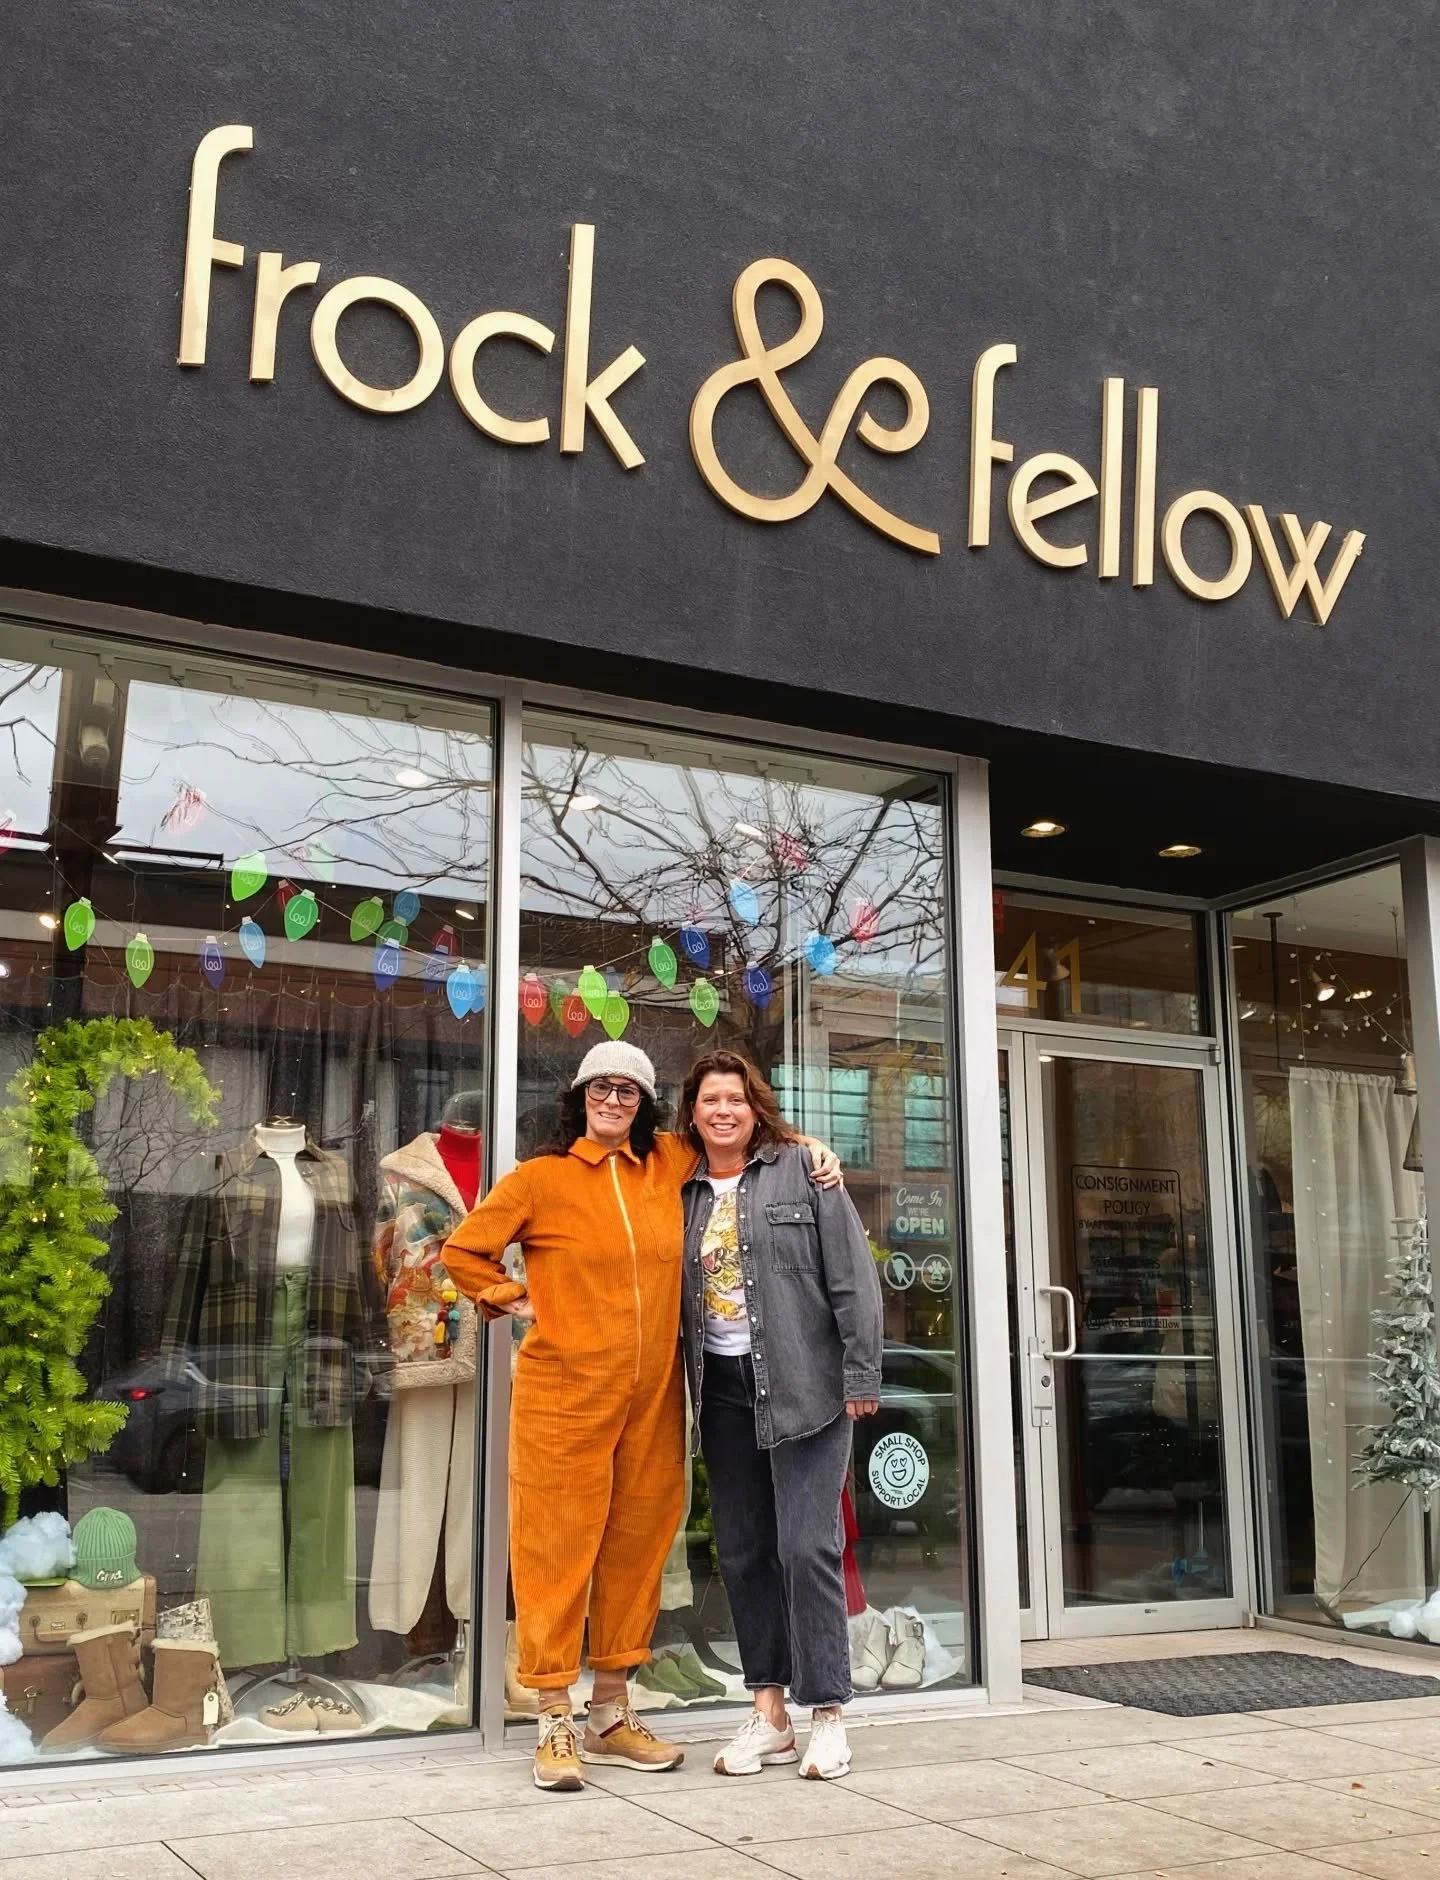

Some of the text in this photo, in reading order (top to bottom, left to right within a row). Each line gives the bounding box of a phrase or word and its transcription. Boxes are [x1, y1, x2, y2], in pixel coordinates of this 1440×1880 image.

[177, 123, 1367, 626] frock & fellow
[1075, 1174, 1177, 1194] CONSIGNMENT
[896, 1187, 944, 1207] Come In
[907, 1207, 930, 1217] WE'RE
[1104, 1200, 1150, 1216] POLICY
[895, 1216, 945, 1235] OPEN
[875, 1435, 926, 1466] SMALL SHOP
[871, 1470, 926, 1506] SUPPORT LOCAL
